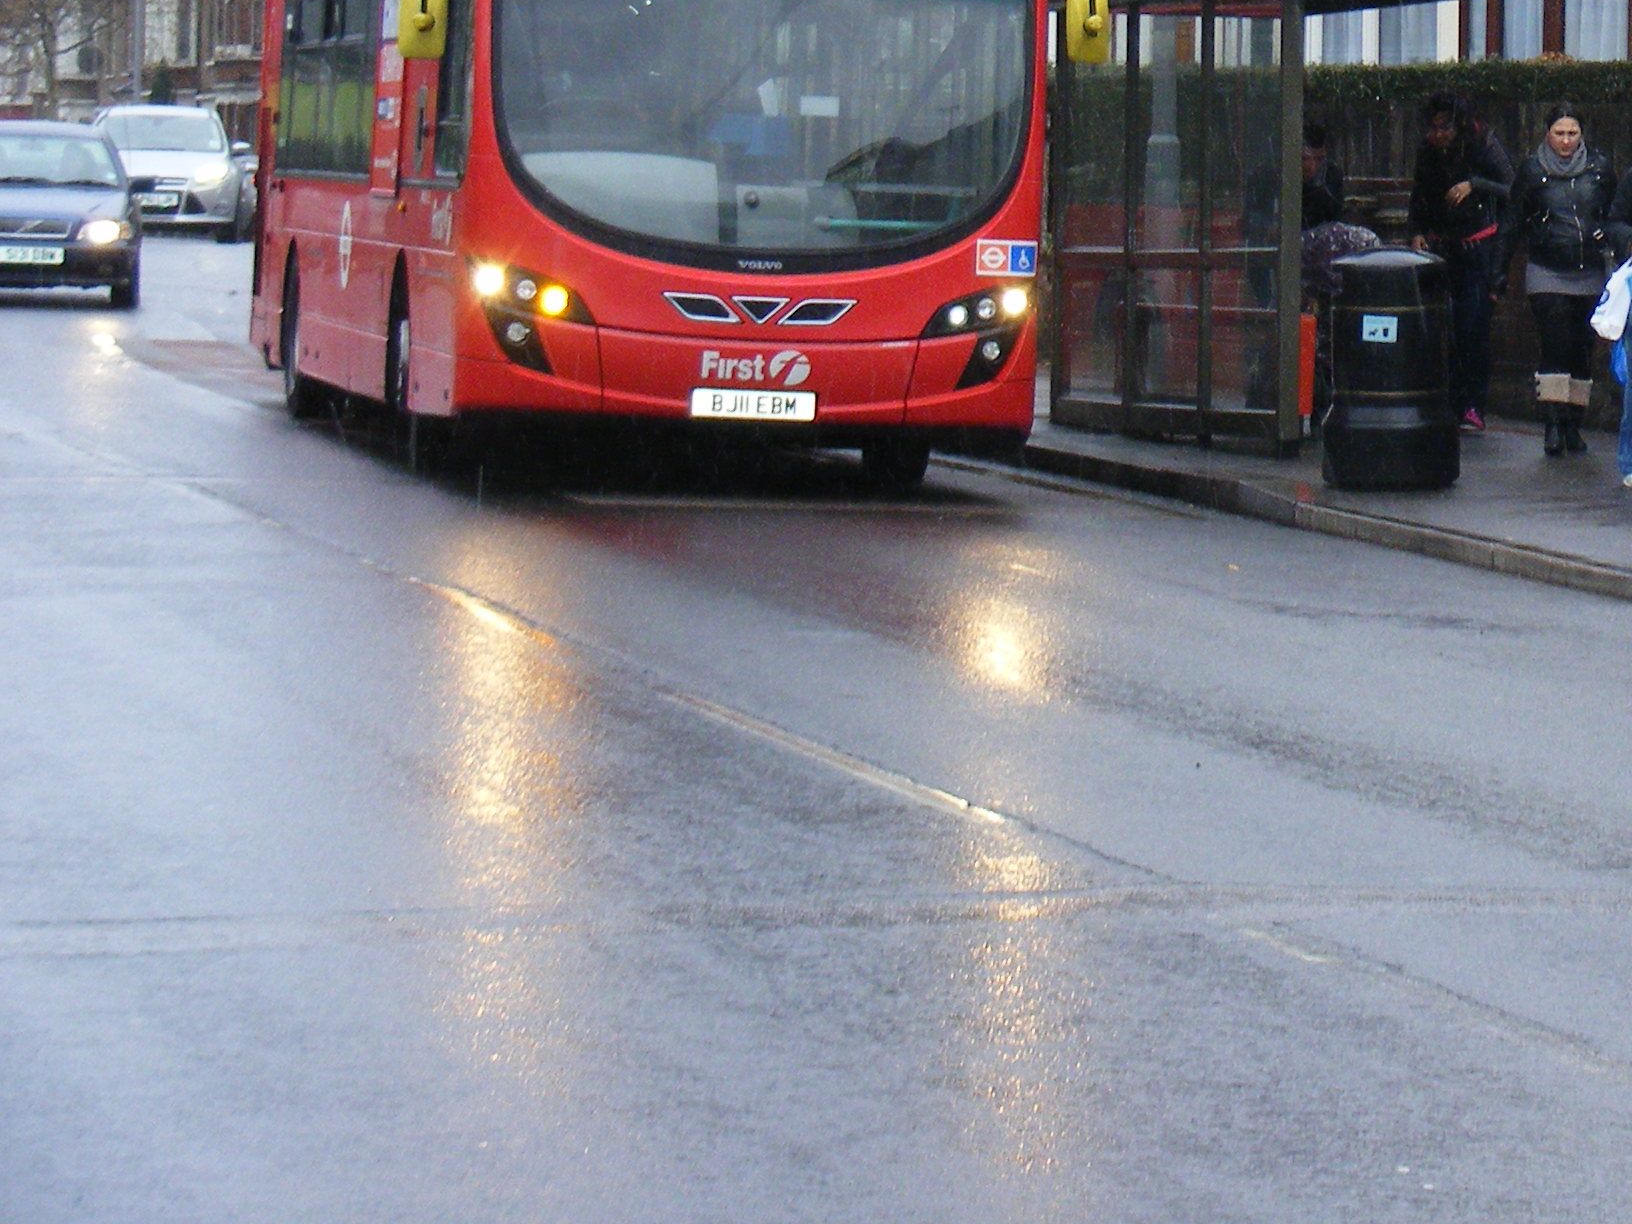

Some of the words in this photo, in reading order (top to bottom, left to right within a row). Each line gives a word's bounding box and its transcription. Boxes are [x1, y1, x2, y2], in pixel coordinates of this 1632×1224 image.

[738, 260, 783, 271] VOLVO
[701, 350, 765, 382] First
[756, 396, 797, 415] EBM
